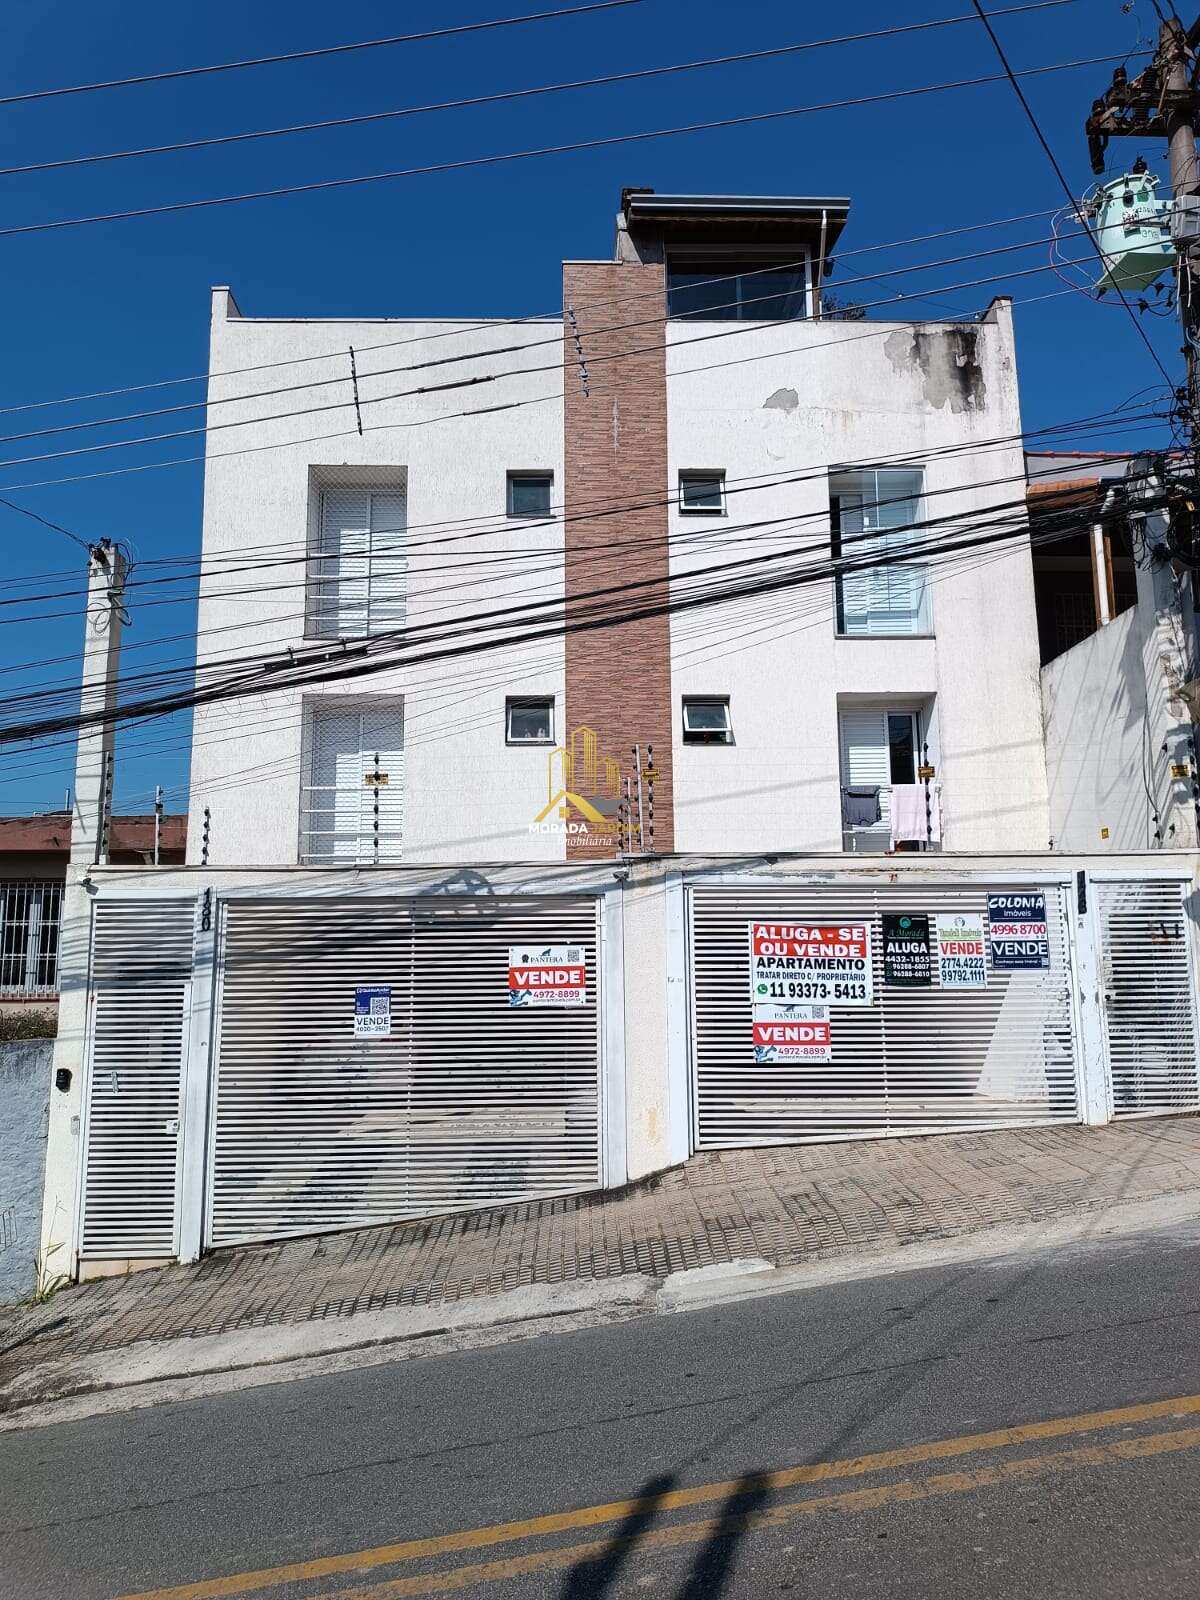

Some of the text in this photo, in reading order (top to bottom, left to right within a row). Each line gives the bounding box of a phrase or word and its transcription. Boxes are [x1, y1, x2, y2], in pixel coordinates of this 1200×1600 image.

[989, 897, 1044, 909] COLONIA
[1003, 909, 1032, 917] Imóveis
[755, 926, 822, 940] ALUGA
[838, 928, 865, 941] SE
[760, 942, 861, 957] OU VENDE
[887, 942, 928, 953] ALUGA
[940, 942, 984, 955] VENDE
[992, 942, 1048, 956] VENDE
[757, 957, 865, 970] APARTAMENTO
[941, 957, 984, 969] 2774.4222
[514, 970, 581, 986] VENDE
[756, 971, 866, 982] TRATAR DIRETO C/ PROPRIETÁRIO
[533, 990, 580, 998] 4972-8899
[770, 982, 785, 998] 11
[834, 984, 866, 999] 5413
[356, 1016, 389, 1026] VENDE
[758, 1027, 827, 1041] VENDE
[778, 1047, 826, 1055] 4972-8899
